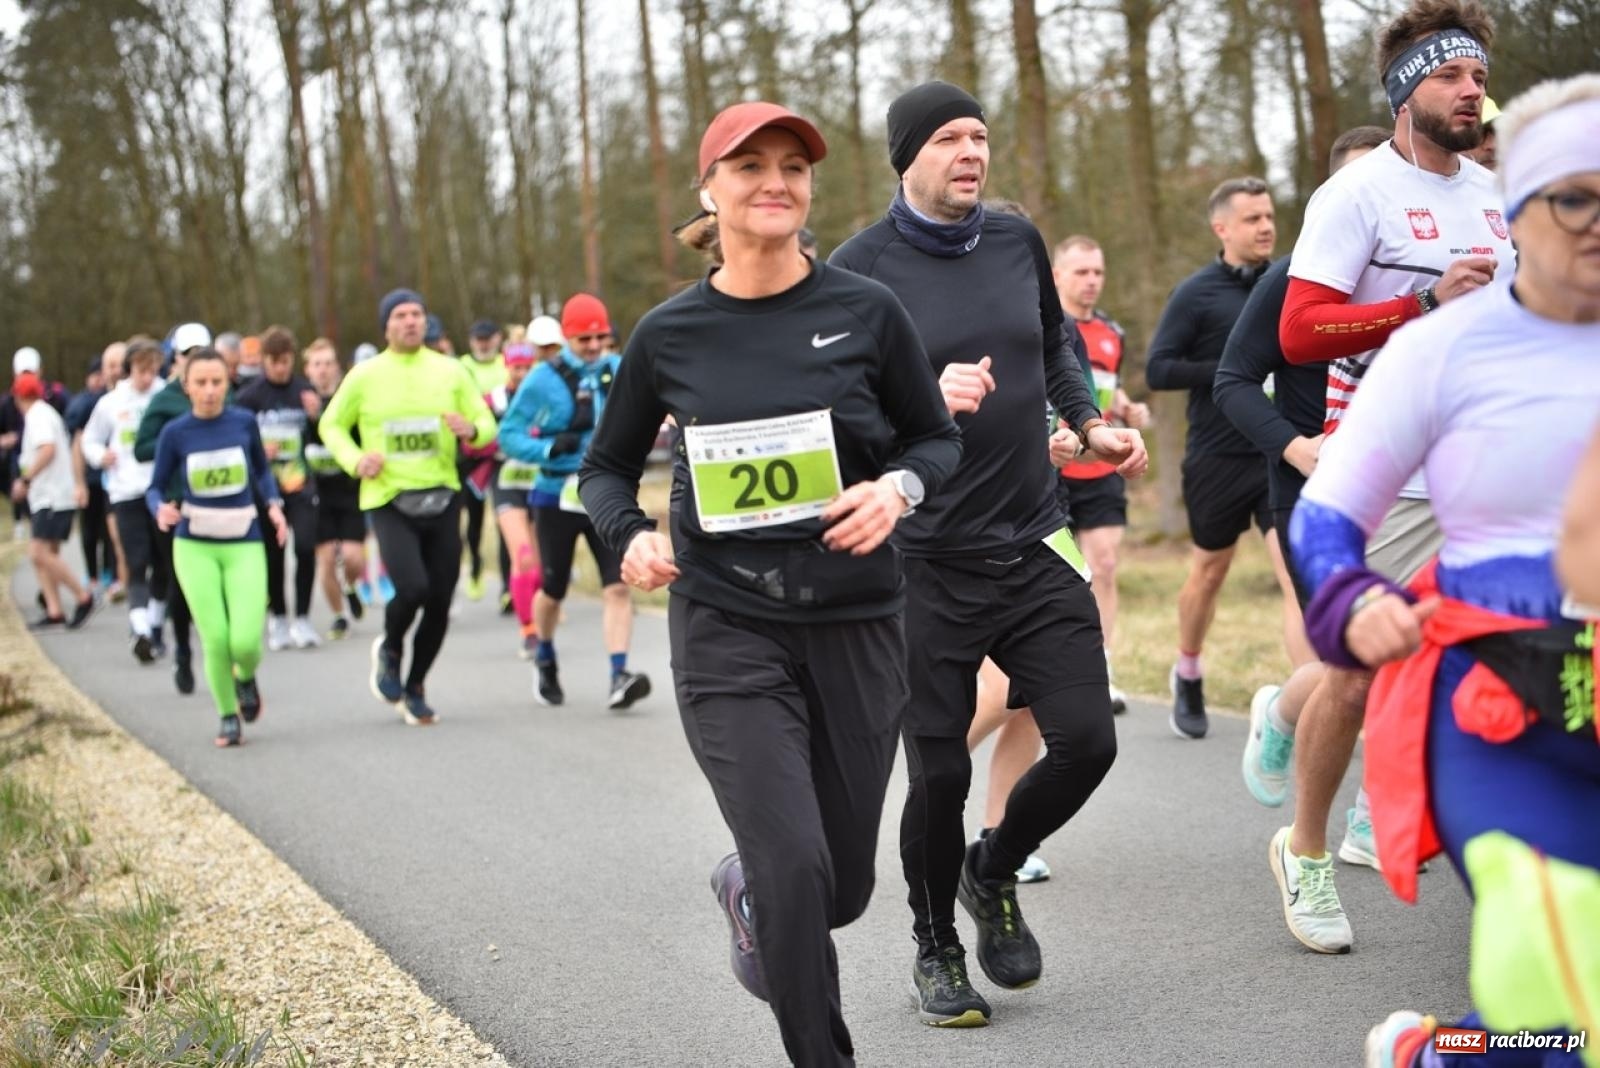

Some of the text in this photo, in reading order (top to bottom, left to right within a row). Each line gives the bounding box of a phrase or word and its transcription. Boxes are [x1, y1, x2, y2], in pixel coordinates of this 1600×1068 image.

[1397, 53, 1426, 85] FUN
[1426, 44, 1439, 60] Z
[393, 433, 433, 452] 105
[204, 467, 232, 487] 62
[729, 459, 799, 509] 20
